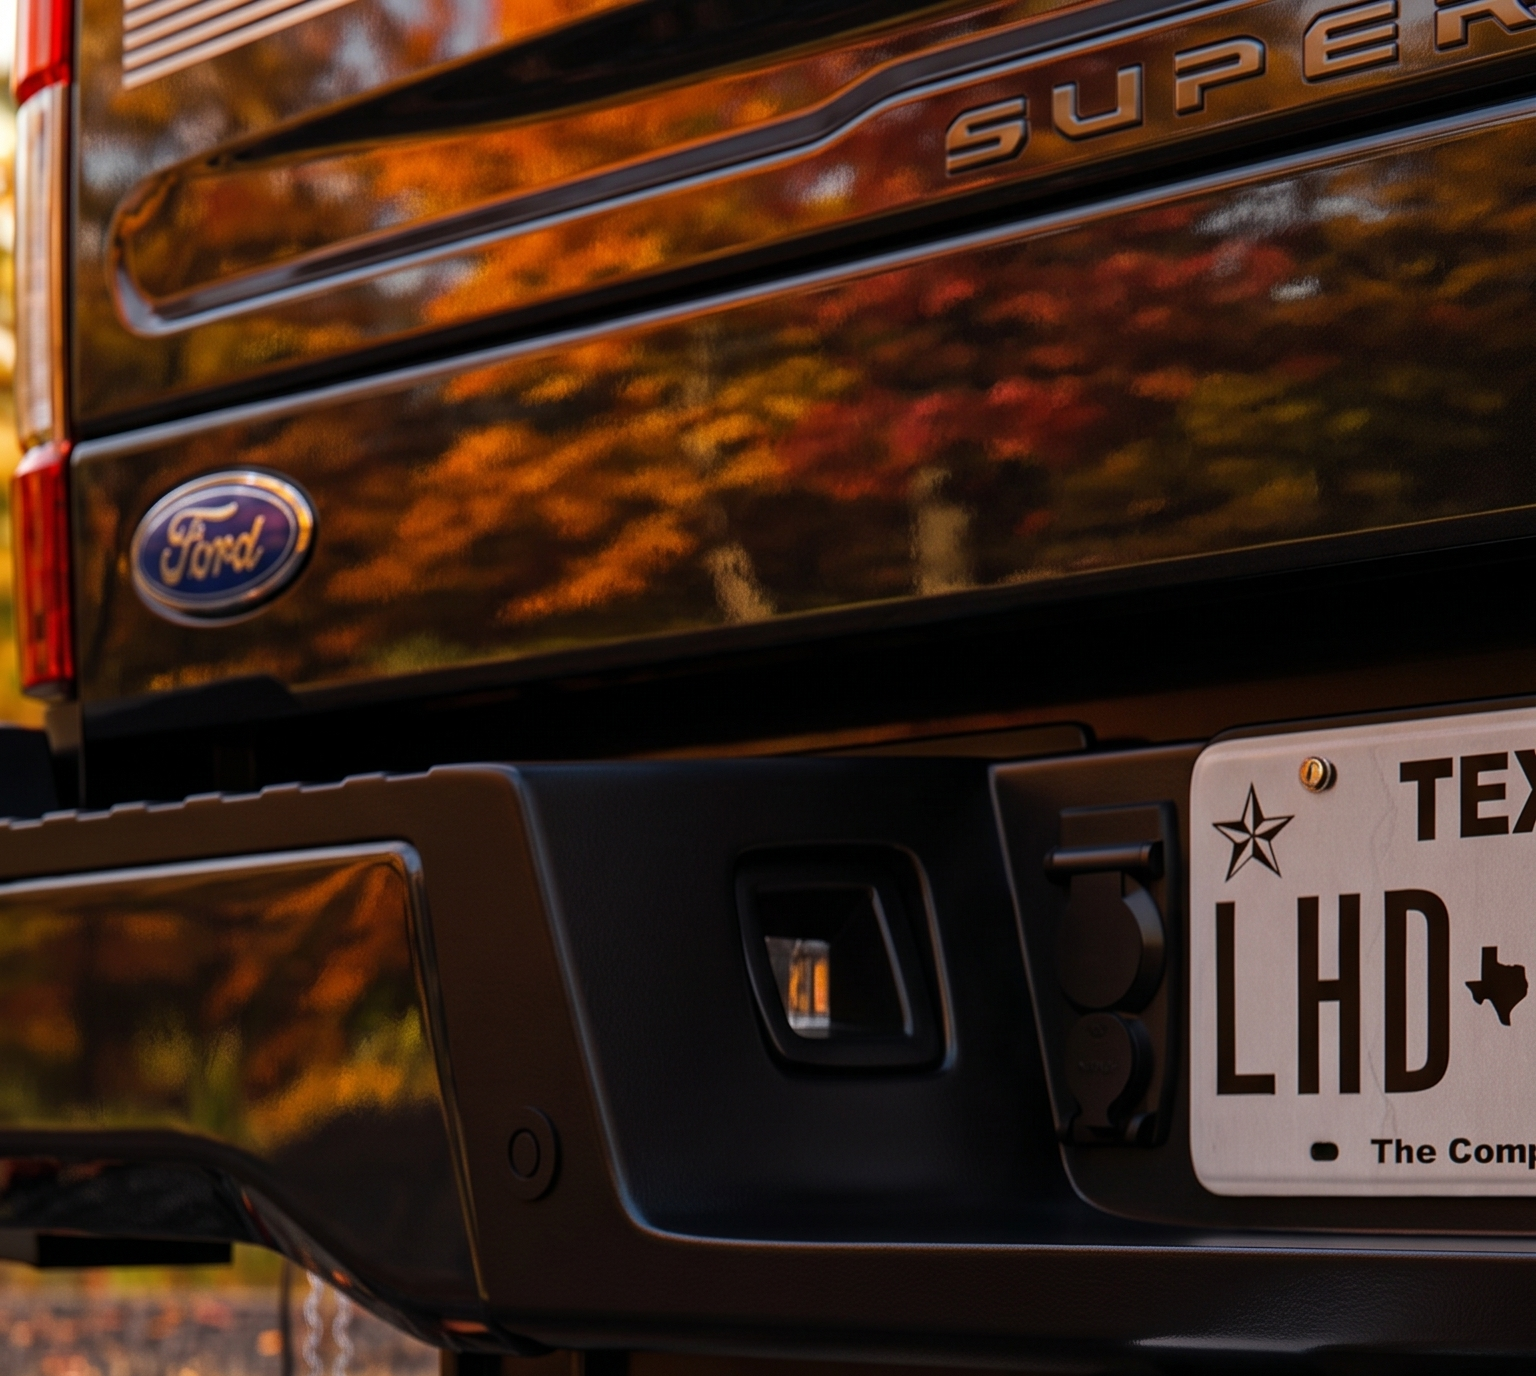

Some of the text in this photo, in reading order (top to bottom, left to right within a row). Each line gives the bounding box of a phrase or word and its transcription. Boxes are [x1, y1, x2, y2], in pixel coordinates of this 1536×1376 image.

[159, 501, 266, 586] Ford
[1215, 889, 1450, 1095] LHD
[1371, 1138, 1436, 1164] The
